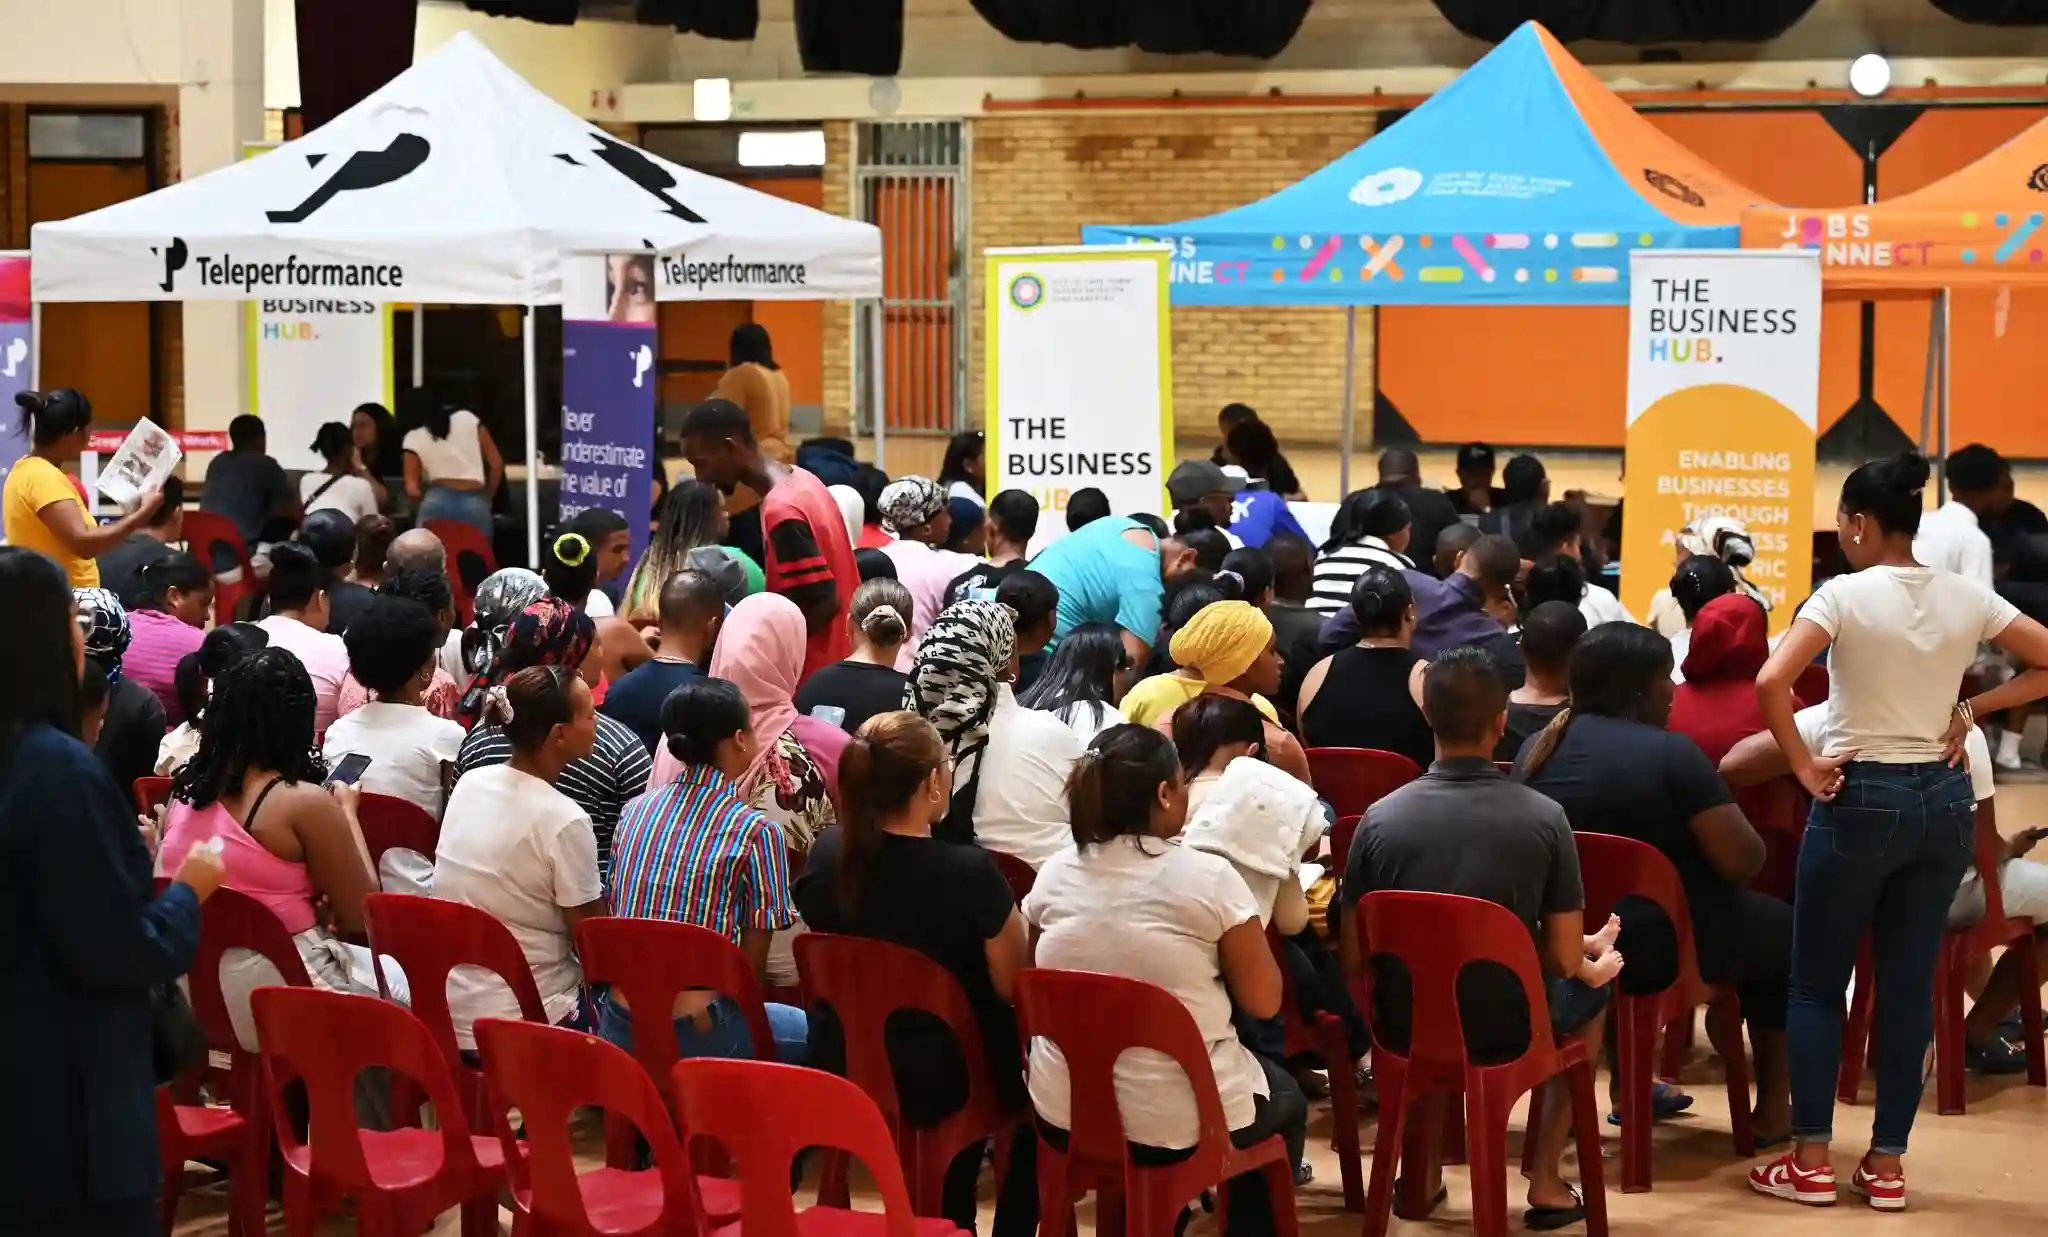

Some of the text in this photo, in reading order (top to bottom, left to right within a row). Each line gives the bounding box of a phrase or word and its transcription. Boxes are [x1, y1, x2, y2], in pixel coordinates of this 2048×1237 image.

[1781, 242, 1935, 267] NNECT
[196, 254, 403, 293] Teleperformance
[661, 254, 806, 291] Teleperformance
[1652, 279, 1709, 302] THE
[1650, 308, 1797, 334] BUSINESS
[1650, 337, 1723, 363] HUB.
[1009, 417, 1066, 439] THE
[1008, 453, 1151, 475] BUSINESS
[1679, 450, 1791, 472] ENABLING
[1657, 475, 1790, 499] BUSINESSES
